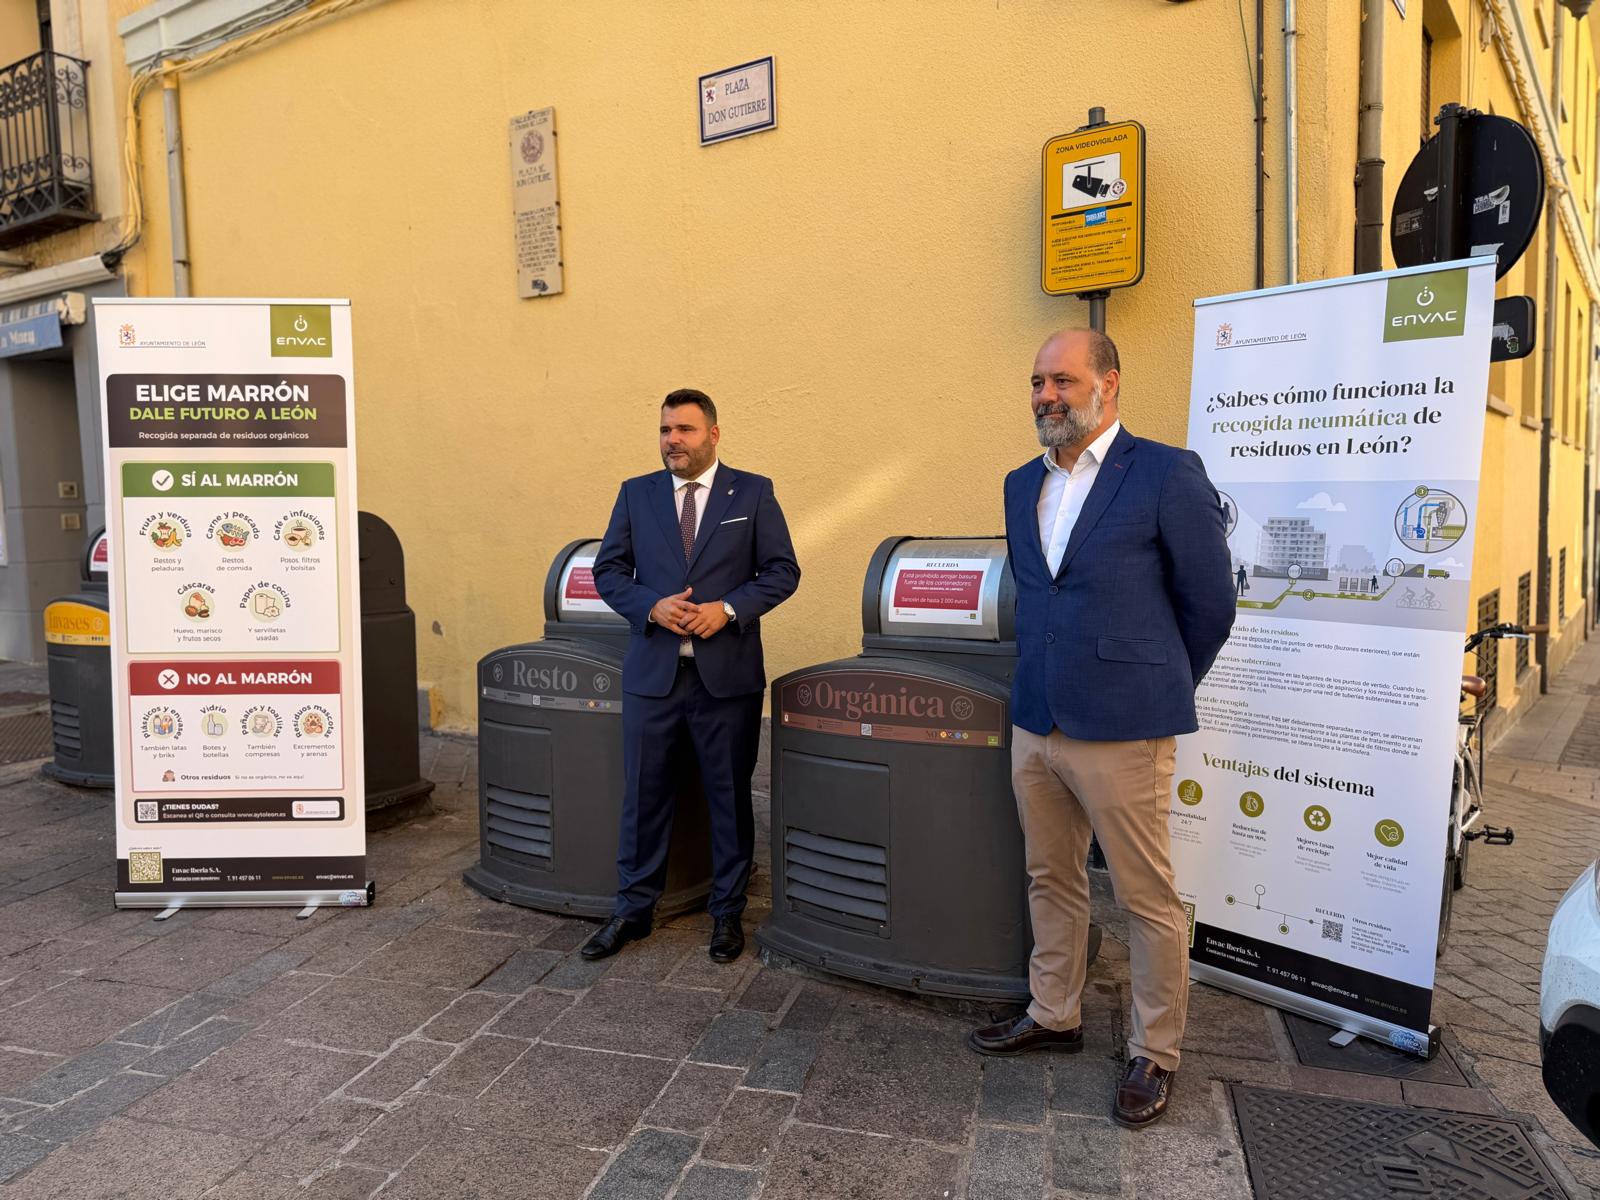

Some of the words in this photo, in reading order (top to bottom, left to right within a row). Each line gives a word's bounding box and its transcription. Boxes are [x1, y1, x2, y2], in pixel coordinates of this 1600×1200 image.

[725, 78, 749, 95] PLAZA
[708, 109, 726, 124] DON
[728, 99, 766, 119] GUTIERRE
[1075, 134, 1128, 150] VIDEOVIGILADA
[1392, 311, 1456, 327] ENVAC
[1235, 335, 1279, 345] AYUNTAMIENTO
[1290, 332, 1307, 340] LEÓN
[136, 384, 200, 402] ELIGE
[208, 381, 309, 402] MARRÓN
[1206, 391, 1268, 413] ¿Sabes
[1273, 386, 1327, 405] cómo
[1332, 380, 1427, 400] funciona
[1434, 376, 1454, 395] la
[130, 408, 175, 420] DALE
[180, 408, 249, 420] FUTURO
[254, 408, 266, 420] A
[271, 405, 317, 420] LEÓN
[1211, 414, 1292, 436] recogida
[1298, 408, 1407, 430] neumática
[1413, 407, 1442, 425] de
[139, 432, 178, 440] Recogida
[180, 432, 218, 440] separada
[269, 431, 309, 440] orgánicos
[1230, 440, 1311, 458] residuos
[1316, 442, 1341, 455] en
[1346, 435, 1412, 455] León?
[181, 471, 196, 486] SÍ
[200, 474, 221, 486] AL
[226, 471, 298, 486] MARRÓN
[139, 513, 157, 536] Fruta
[158, 511, 164, 519] y
[167, 511, 192, 539] verdura
[206, 514, 222, 539] Carne
[232, 511, 260, 540] pescado
[273, 520, 282, 541] Café
[289, 509, 325, 541] infusiones
[177, 581, 216, 596] Cáscaras
[240, 585, 256, 609] Papel
[272, 583, 291, 608] cocina
[1271, 629, 1299, 637] residuos
[187, 673, 211, 685] NO
[215, 673, 237, 685] AL
[241, 670, 312, 685] MARRÓN
[513, 660, 577, 691] Resto
[200, 704, 227, 714] Vidrio
[815, 681, 945, 719] Orgánica
[1220, 699, 1248, 708] recogida
[140, 705, 162, 738] Plásticos
[170, 708, 184, 740] envases
[240, 705, 258, 736] Pañales
[260, 704, 265, 712] y
[267, 706, 283, 739] toallitas
[292, 704, 312, 738] Residuos
[313, 704, 334, 739] mascotas
[1203, 753, 1270, 778] Ventajas
[1274, 766, 1300, 783] del
[1304, 772, 1375, 797] sistema
[1296, 837, 1318, 847] Mejores
[1306, 847, 1331, 857] reciclaje
[1366, 852, 1383, 861] Mejor
[1385, 856, 1408, 866] calidad
[1206, 937, 1225, 947] Envac
[1227, 943, 1246, 954] Iberia
[1247, 949, 1260, 958] S.A.
[1311, 981, 1358, 999] envac@envac.es
